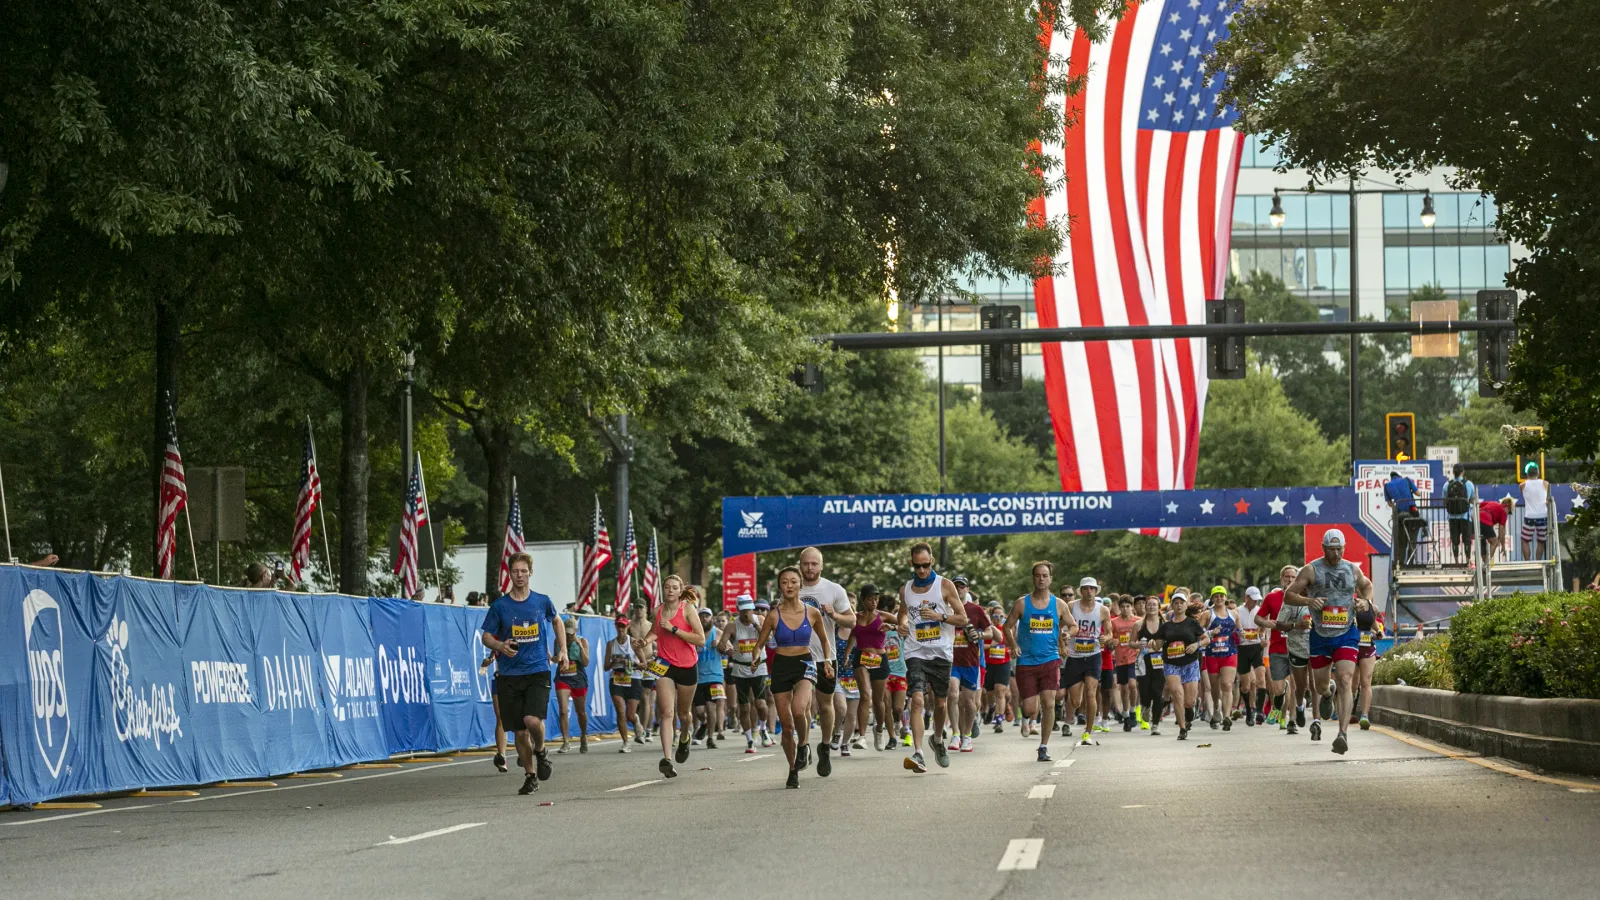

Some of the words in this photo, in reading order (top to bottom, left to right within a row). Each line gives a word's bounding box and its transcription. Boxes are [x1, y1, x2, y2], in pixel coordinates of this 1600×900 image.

[823, 500, 897, 513] ATLANTA
[901, 496, 1112, 512] JOURNAL-CONSTITUTION
[872, 514, 964, 528] PEACHTREE
[969, 513, 1016, 527] ROAD
[1022, 512, 1064, 526] RACE
[379, 644, 428, 704] Publix
